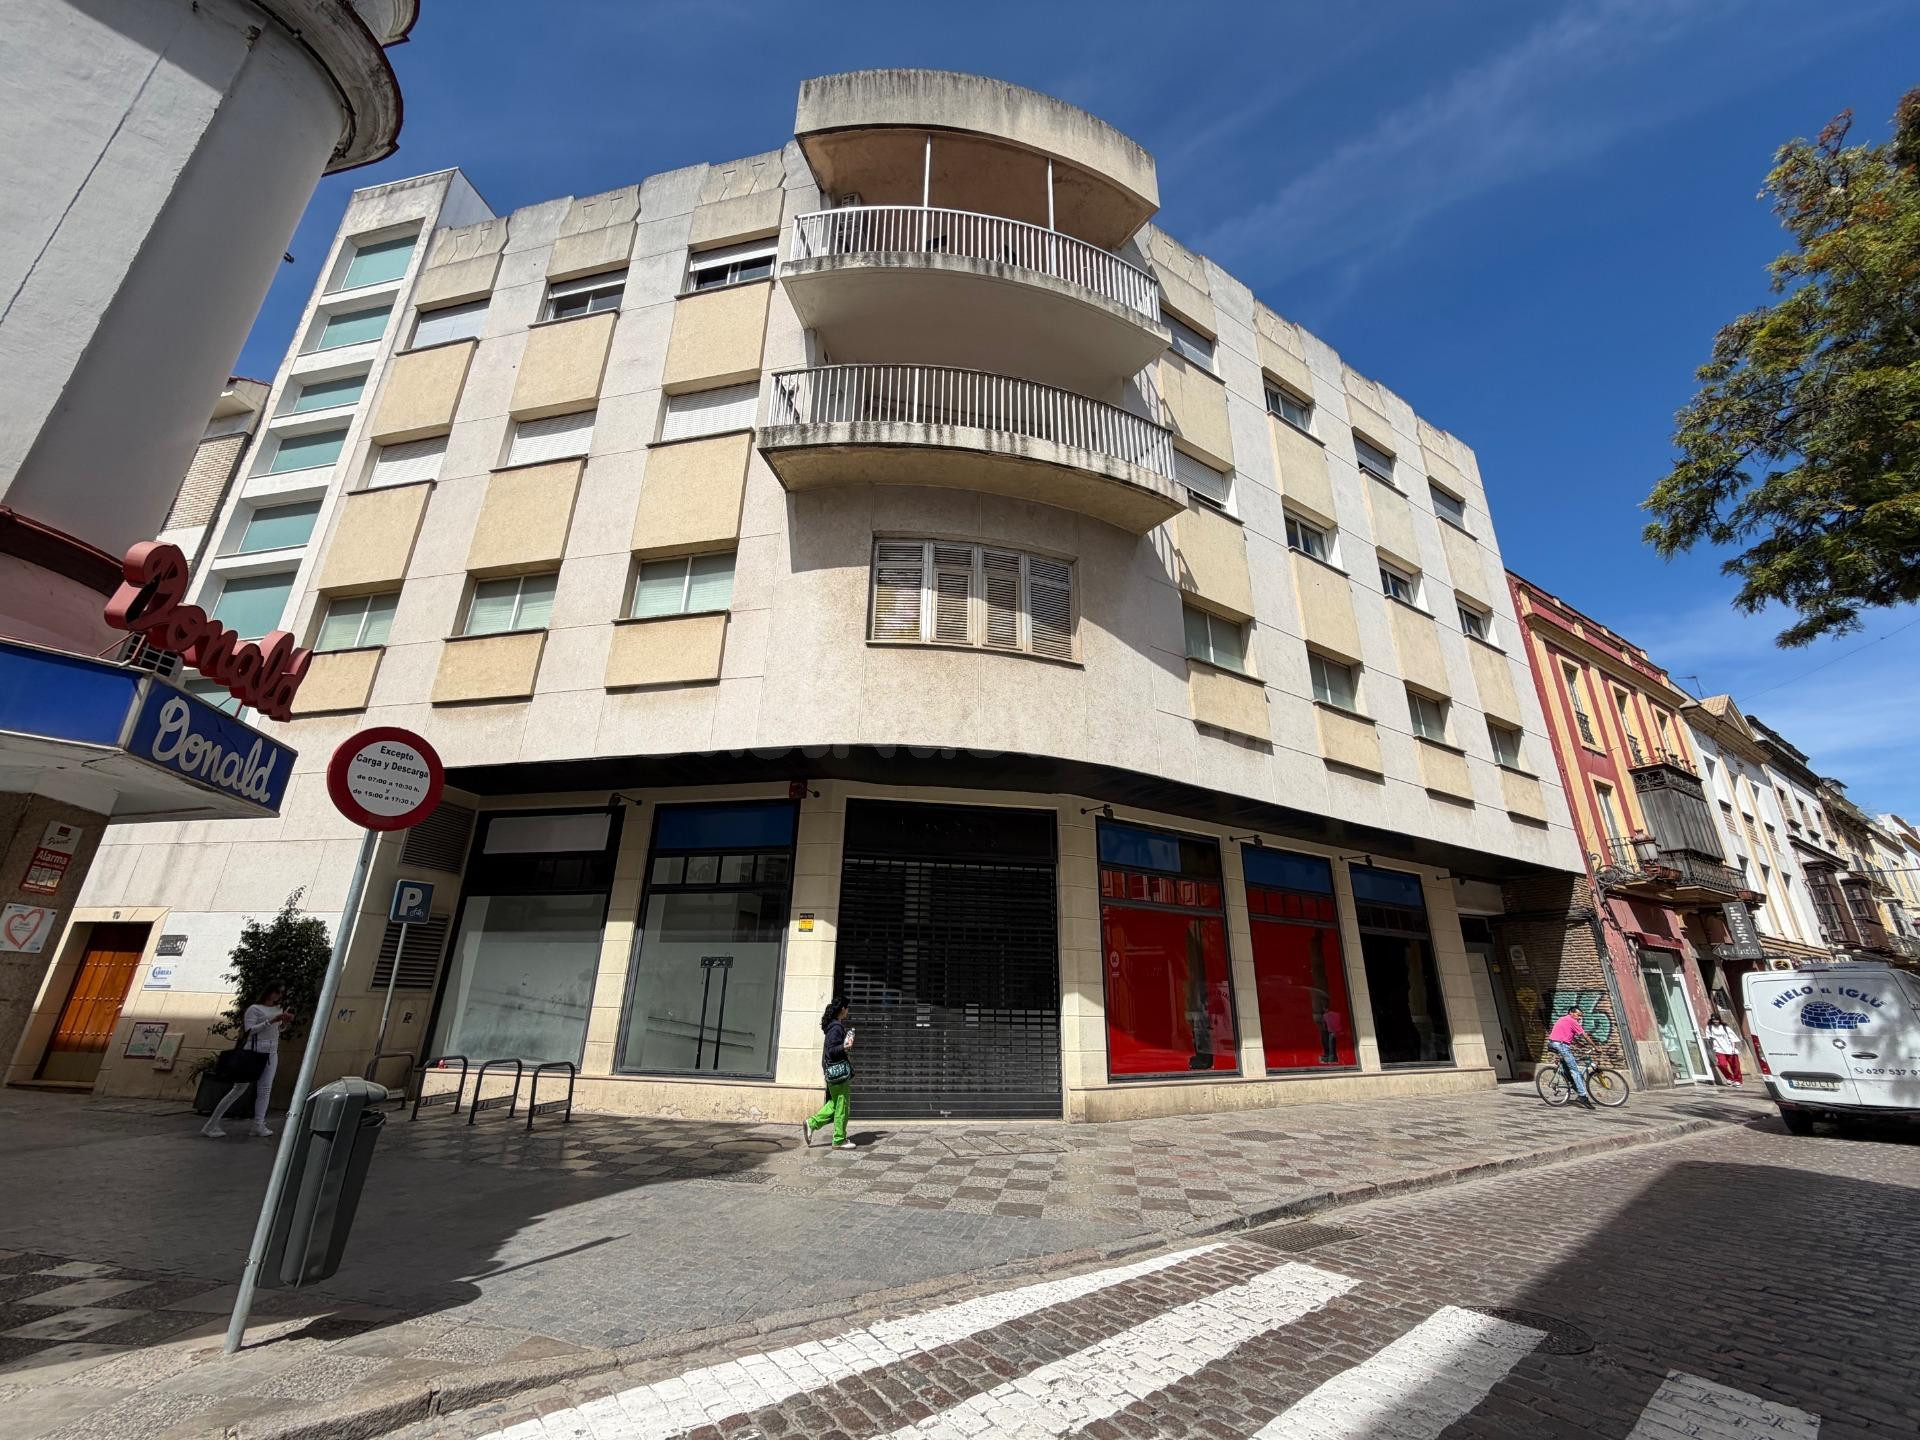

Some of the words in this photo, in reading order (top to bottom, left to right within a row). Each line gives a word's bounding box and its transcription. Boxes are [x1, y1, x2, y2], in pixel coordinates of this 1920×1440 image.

[104, 541, 314, 723] Donald
[152, 696, 278, 804] Donald
[380, 745, 414, 761] Excepto
[356, 753, 382, 767] Carga
[383, 761, 390, 770] y
[391, 762, 429, 779] Descarga
[368, 776, 387, 785] 07:00
[395, 782, 413, 791] 10:30
[35, 850, 68, 865] Alarma
[399, 886, 423, 916] P
[1771, 986, 1814, 1010] HIELO
